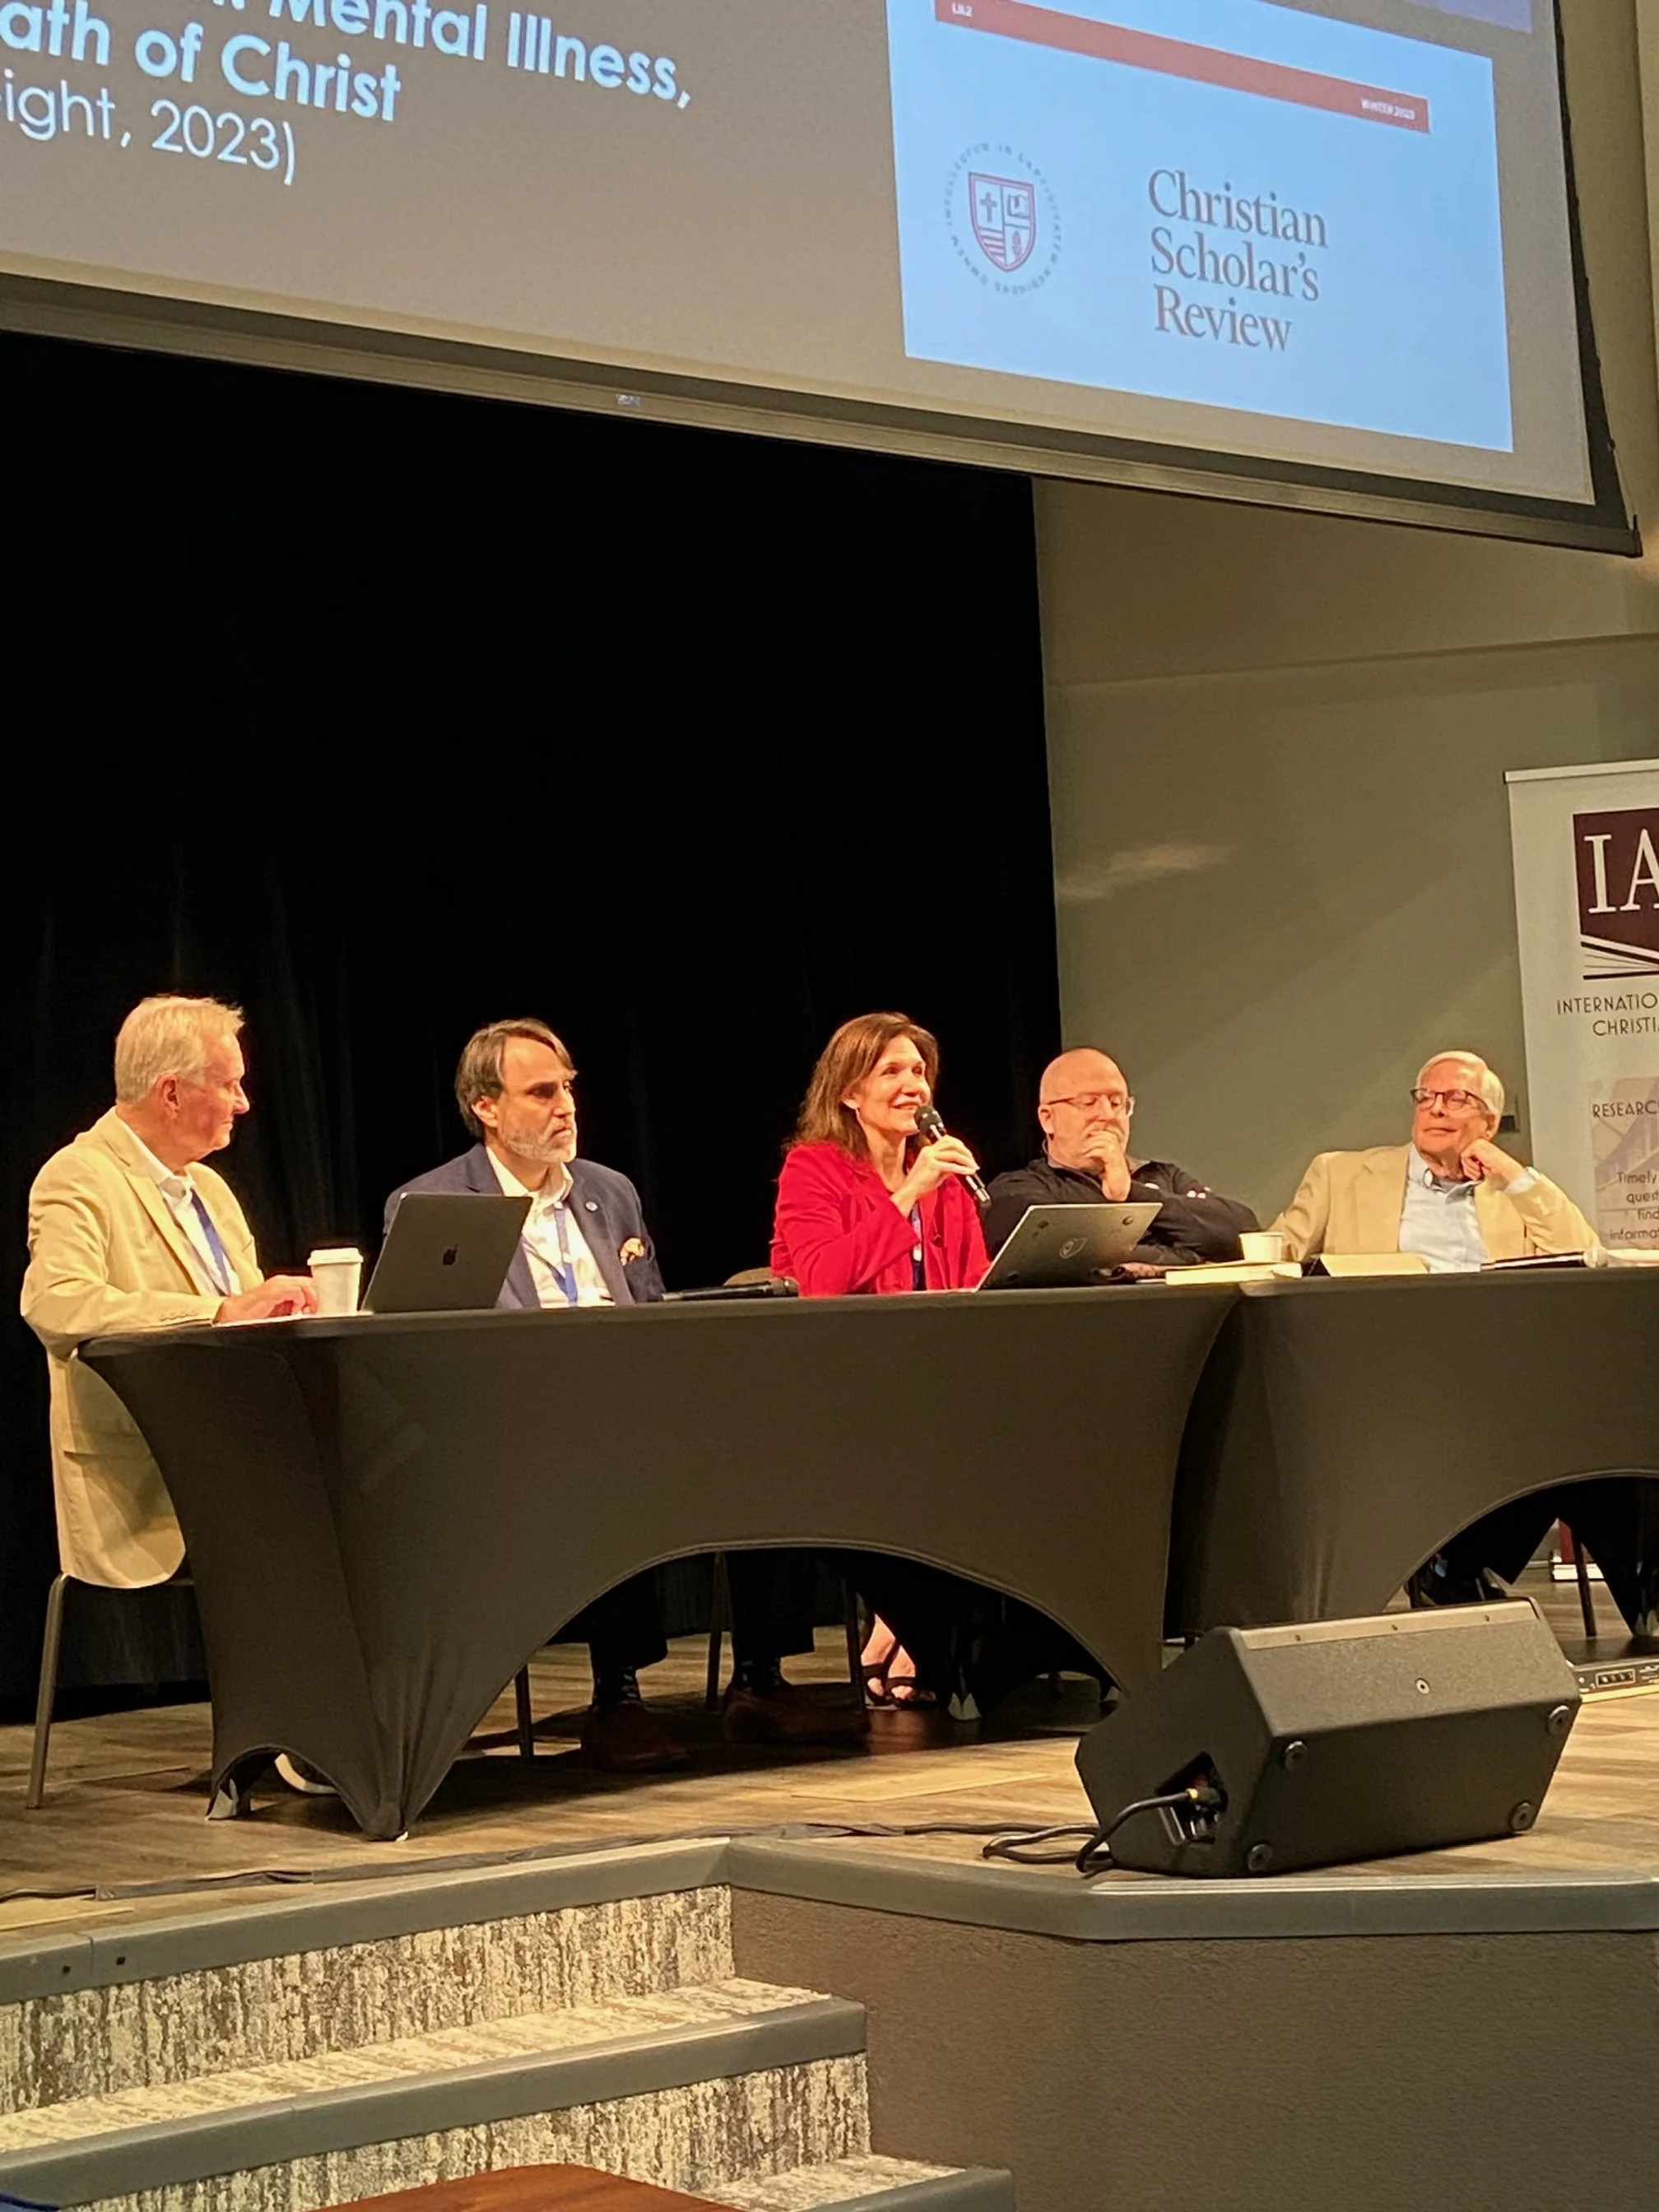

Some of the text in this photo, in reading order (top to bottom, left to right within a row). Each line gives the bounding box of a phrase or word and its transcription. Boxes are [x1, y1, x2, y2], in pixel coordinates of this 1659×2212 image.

[135, 21, 204, 82] of
[221, 34, 402, 121] Christ
[507, 12, 691, 109] Illness,
[0, 67, 296, 186] ight, 2023)
[1148, 169, 1328, 249] Christian
[1153, 283, 1293, 352] Review
[1556, 992, 1658, 1015] INTERNATIO
[1592, 1016, 1659, 1037] CHRISTI
[1592, 1099, 1659, 1119] RESEARC
[1618, 1169, 1657, 1184] Timely
[1610, 1227, 1659, 1241] informa
